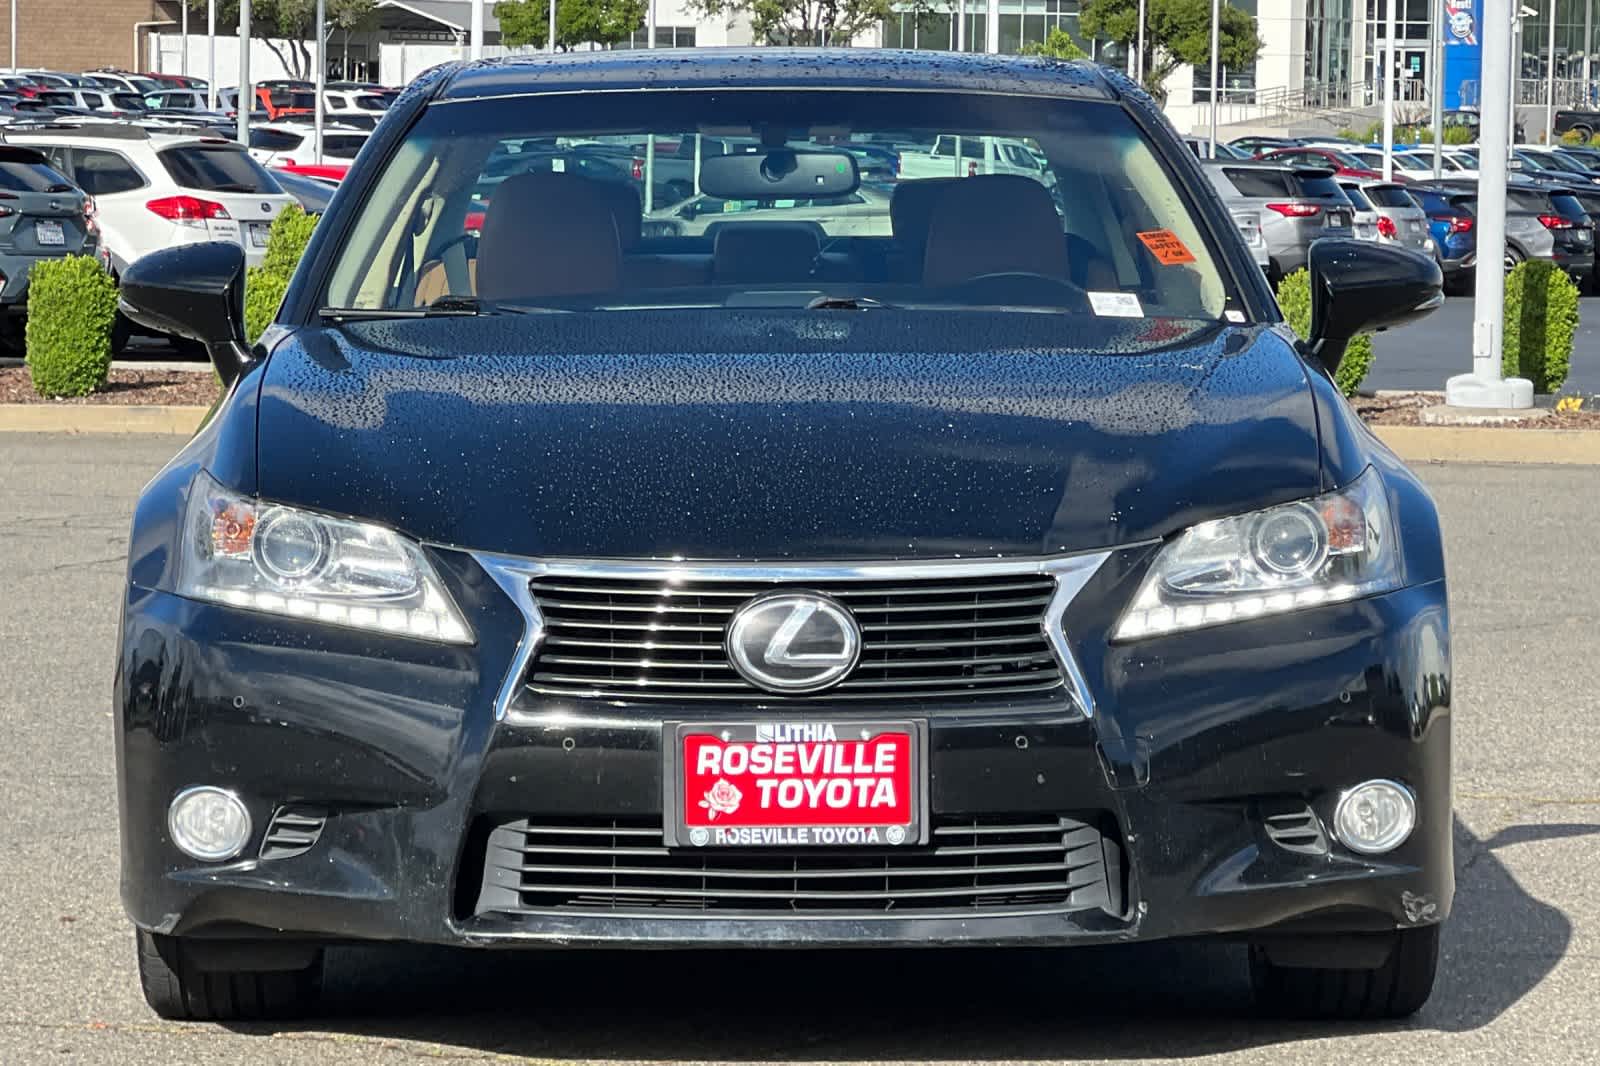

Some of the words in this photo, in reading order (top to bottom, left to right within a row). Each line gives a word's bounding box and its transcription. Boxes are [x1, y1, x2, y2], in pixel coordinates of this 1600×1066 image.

[774, 723, 837, 742] LITHIA
[696, 743, 897, 776] ROSEVILLE
[756, 777, 897, 809] TOYOTA
[715, 827, 809, 845] ROSEVILLE
[812, 827, 880, 844] TOYOTA
